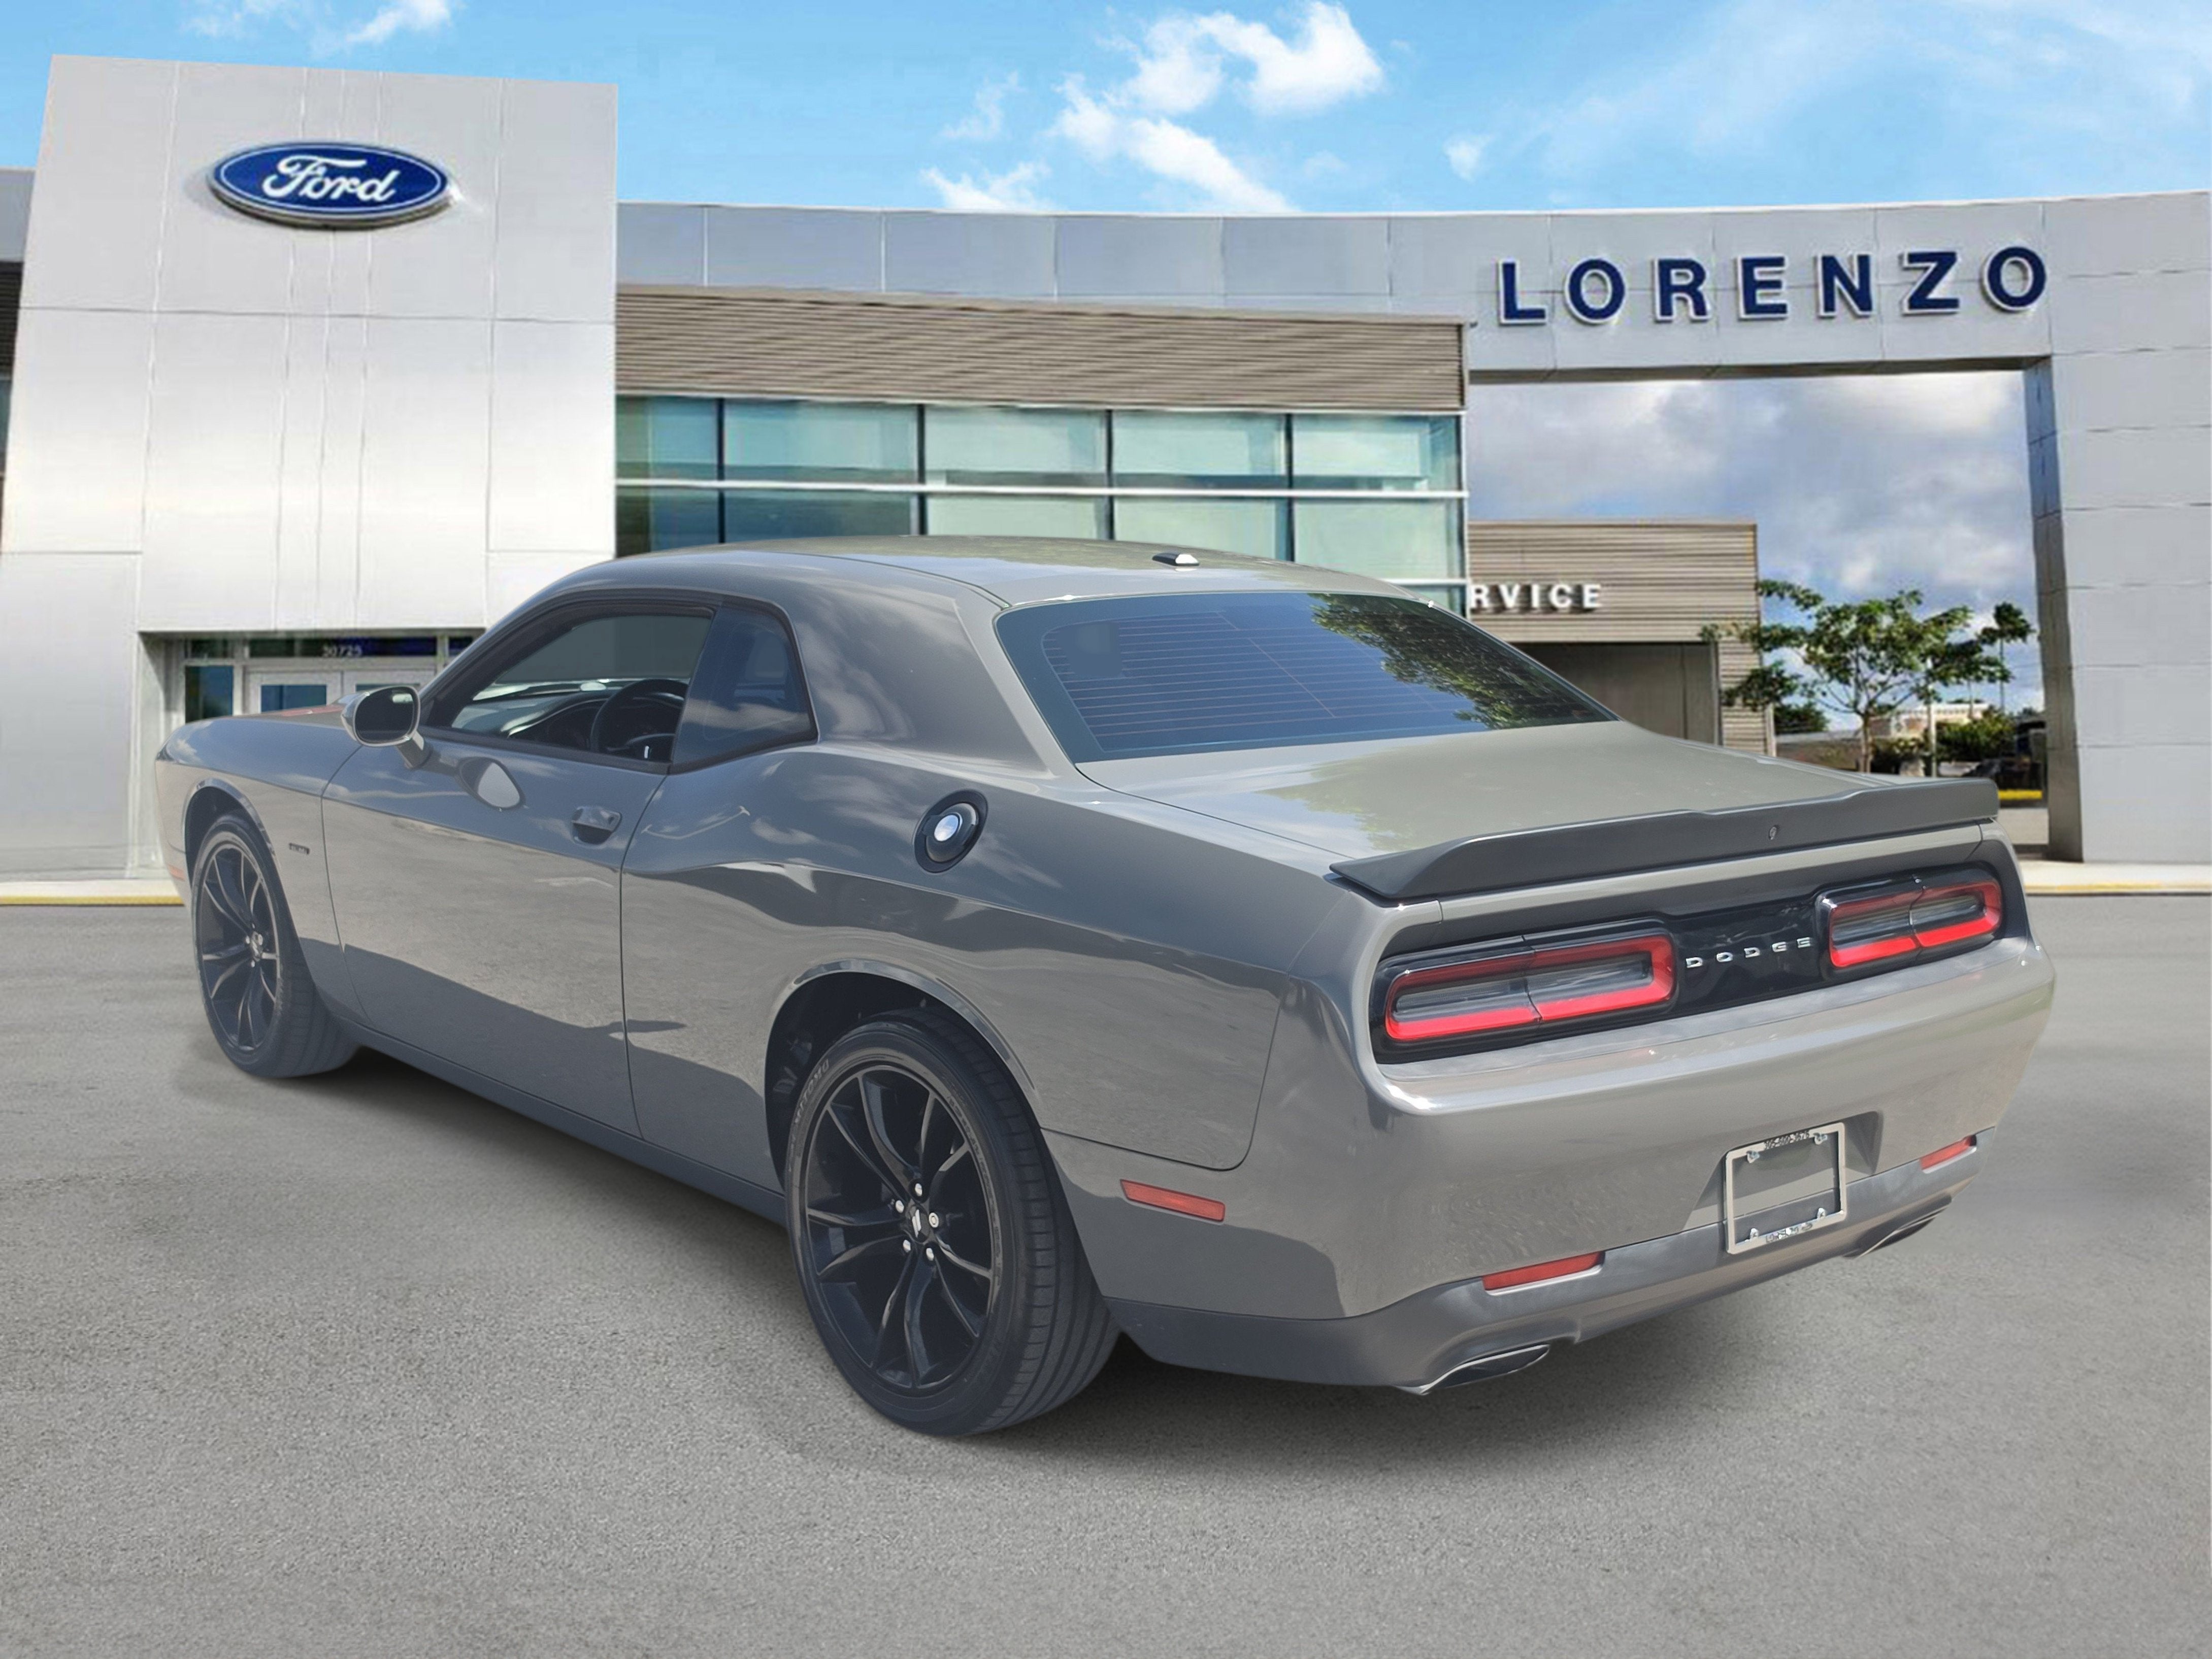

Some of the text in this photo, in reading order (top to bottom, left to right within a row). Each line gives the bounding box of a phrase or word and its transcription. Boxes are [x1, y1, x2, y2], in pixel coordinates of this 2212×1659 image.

[261, 154, 401, 202] Ford
[1498, 246, 2046, 324] LORENZO
[1472, 583, 1602, 608] RVICE
[1686, 937, 1811, 968] DODGE
